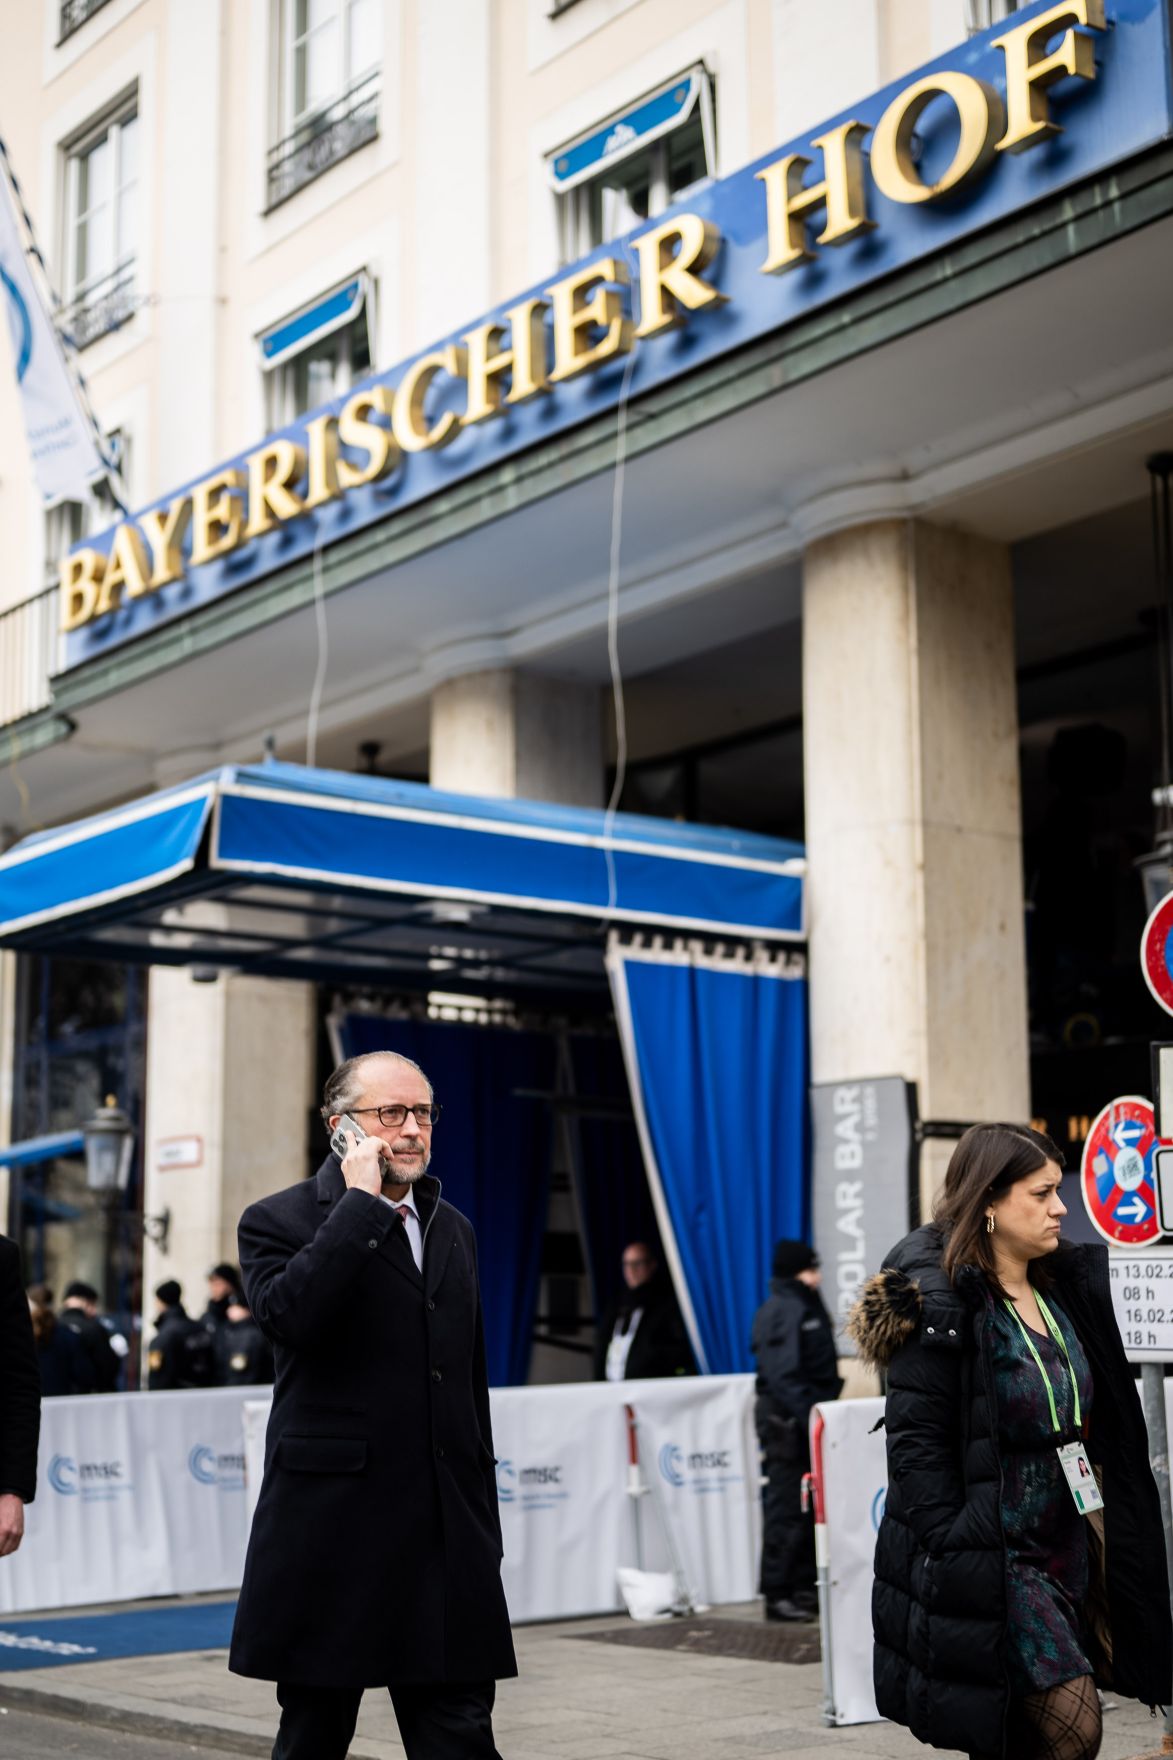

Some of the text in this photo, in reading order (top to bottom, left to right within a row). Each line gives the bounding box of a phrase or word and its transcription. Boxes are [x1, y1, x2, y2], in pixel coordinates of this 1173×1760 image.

[58, 0, 1107, 633] BAYERISCHER HOF
[833, 1085, 863, 1170] BAR
[1123, 1286, 1155, 1300] 08 h
[1127, 1330, 1157, 1345] 18 h
